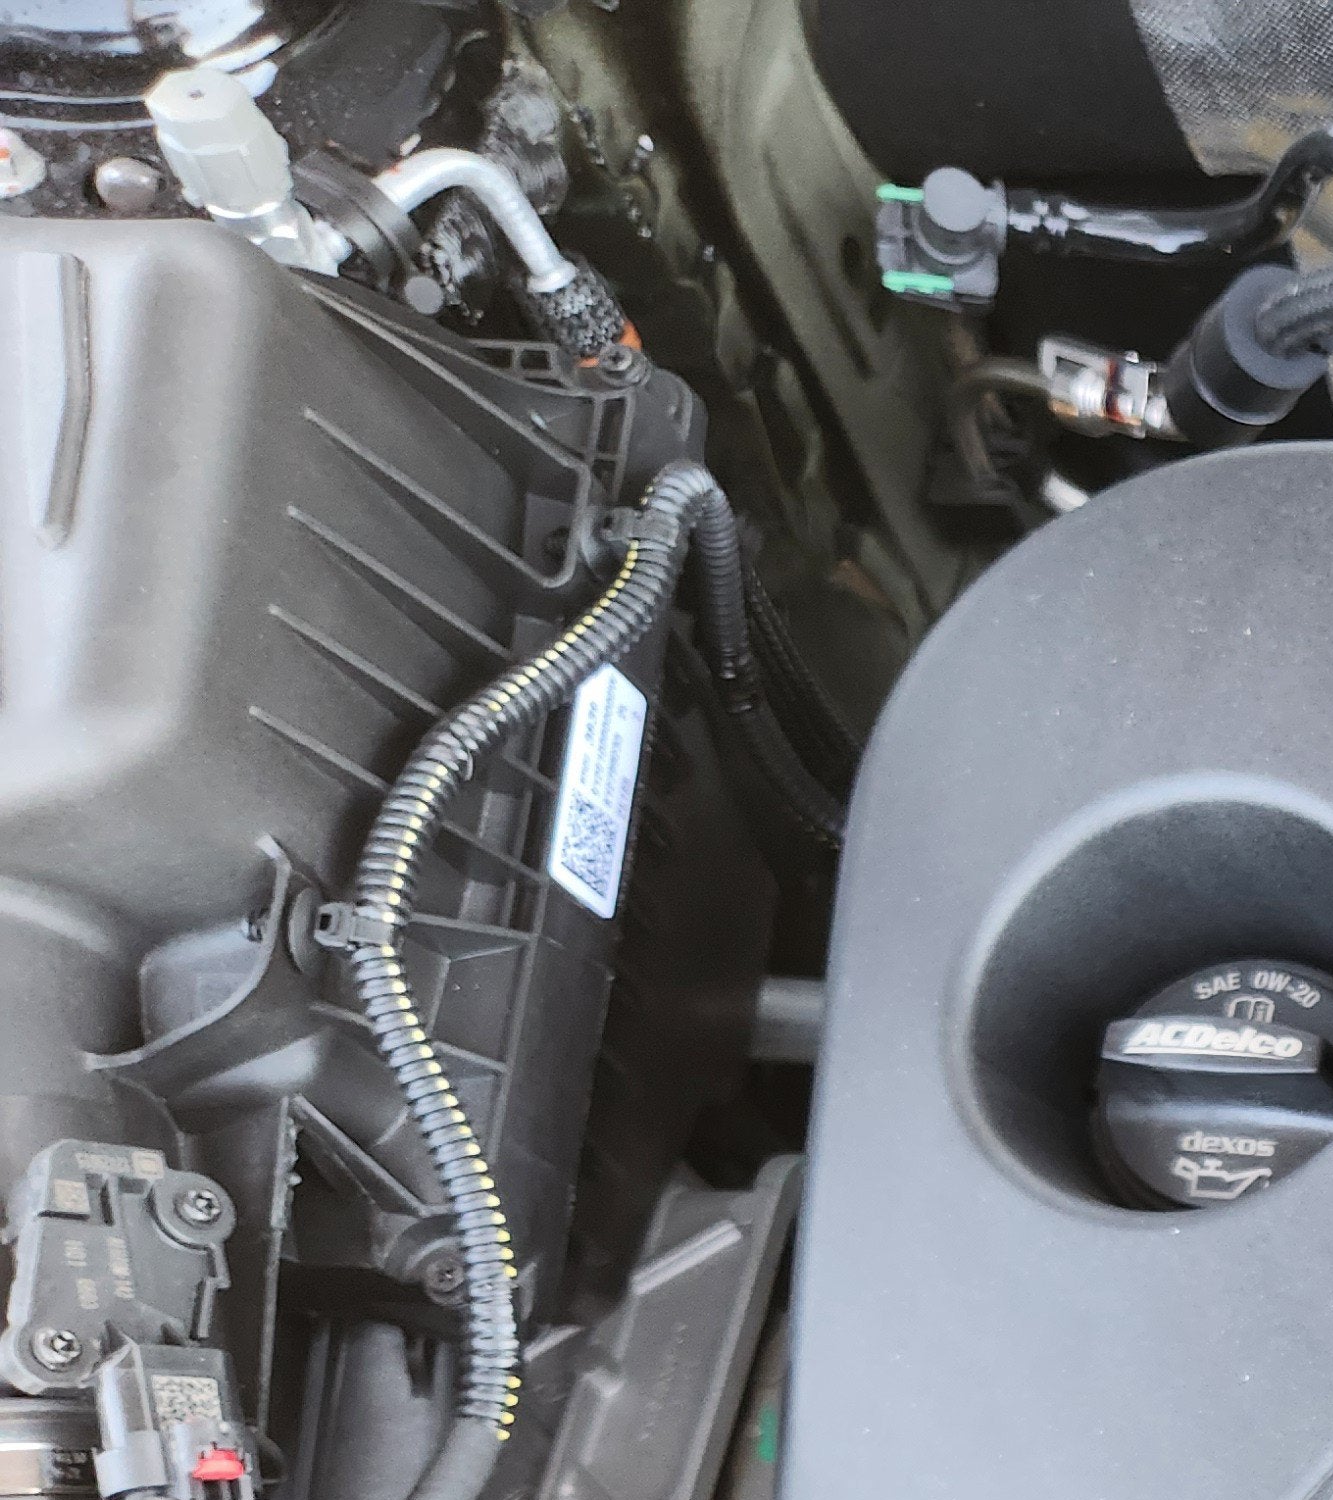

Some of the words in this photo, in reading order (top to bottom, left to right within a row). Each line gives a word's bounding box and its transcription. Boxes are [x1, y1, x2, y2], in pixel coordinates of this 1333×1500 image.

[1195, 972, 1242, 1000] SAE
[1254, 970, 1322, 1009] 0W-20
[1125, 1021, 1303, 1059] ACDelco
[1181, 1131, 1278, 1157] dexos
